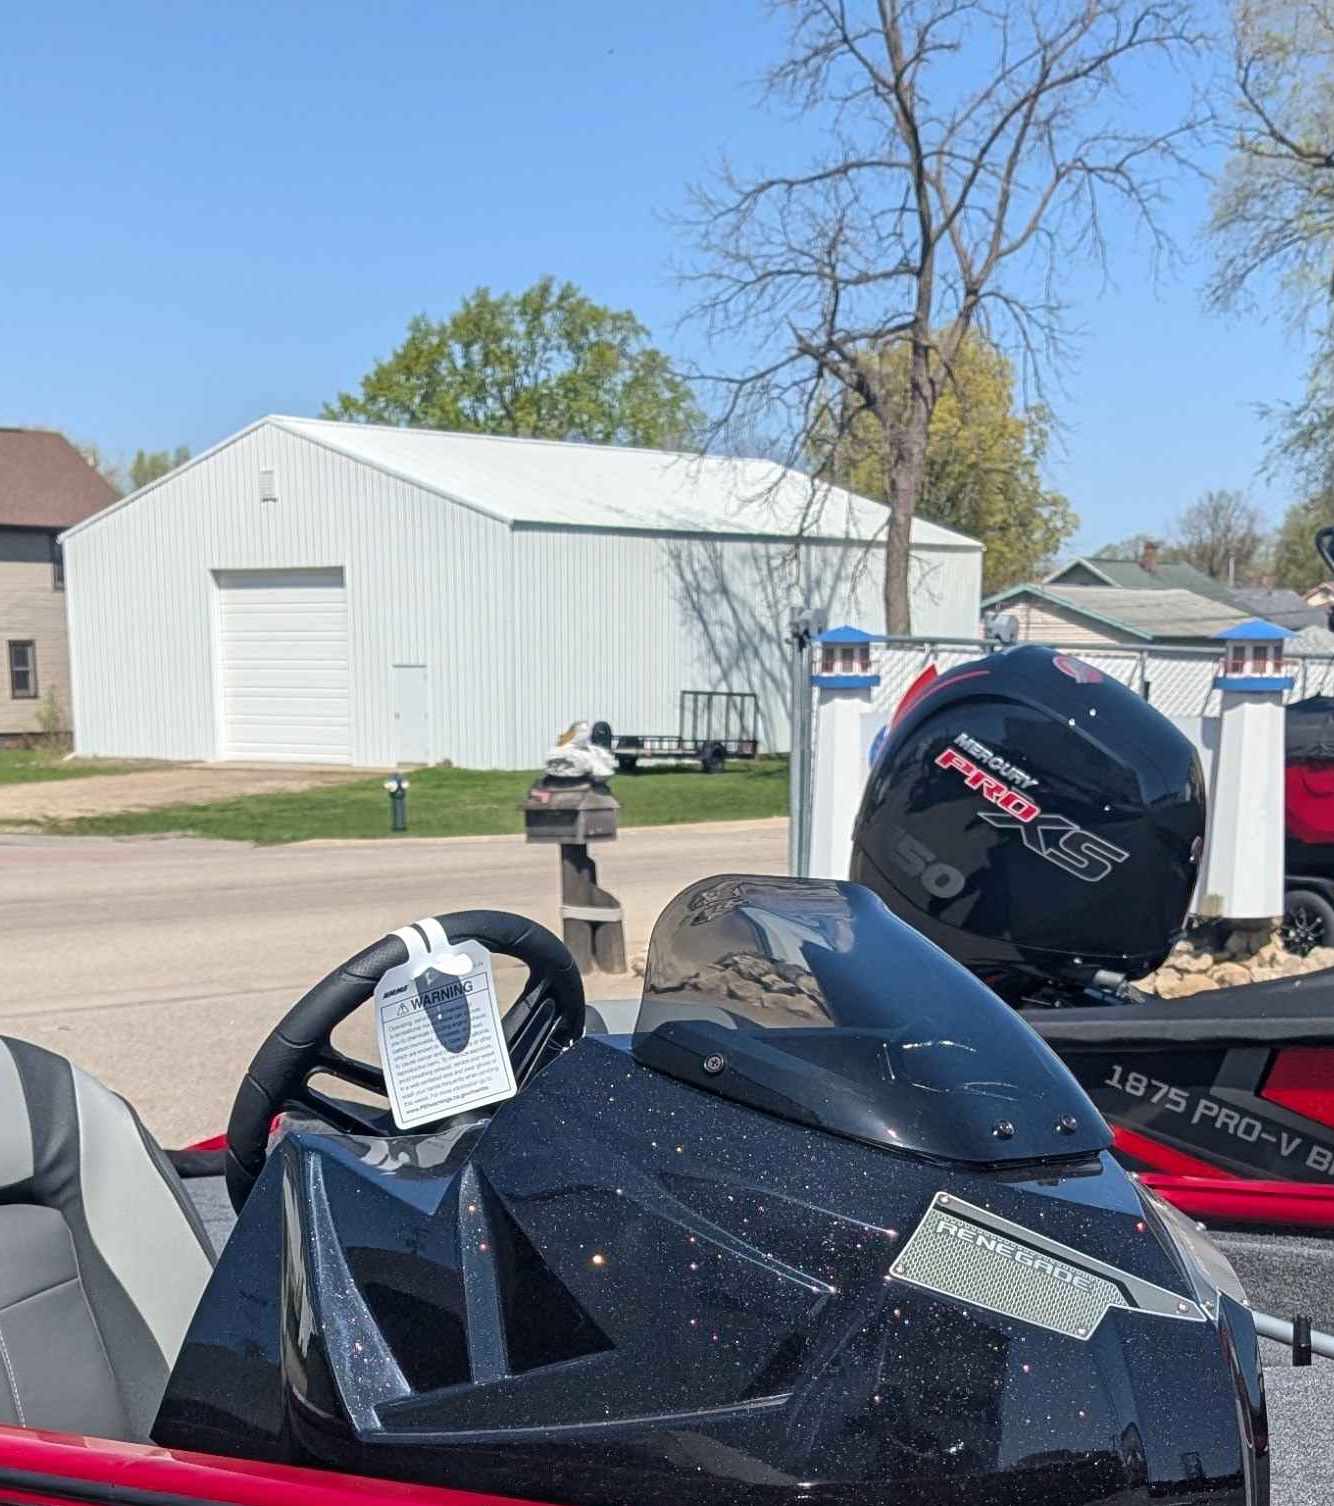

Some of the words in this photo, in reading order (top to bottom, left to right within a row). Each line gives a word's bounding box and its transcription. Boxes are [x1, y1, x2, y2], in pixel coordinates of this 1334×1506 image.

[934, 748, 1041, 823] PRO
[953, 732, 1039, 790] MERCURY
[977, 811, 1130, 882] XS
[411, 980, 473, 1010] WARNING
[1104, 1063, 1187, 1114] 1875
[1191, 1098, 1303, 1158] PRO-V
[936, 1219, 1093, 1292] RENEGADE
